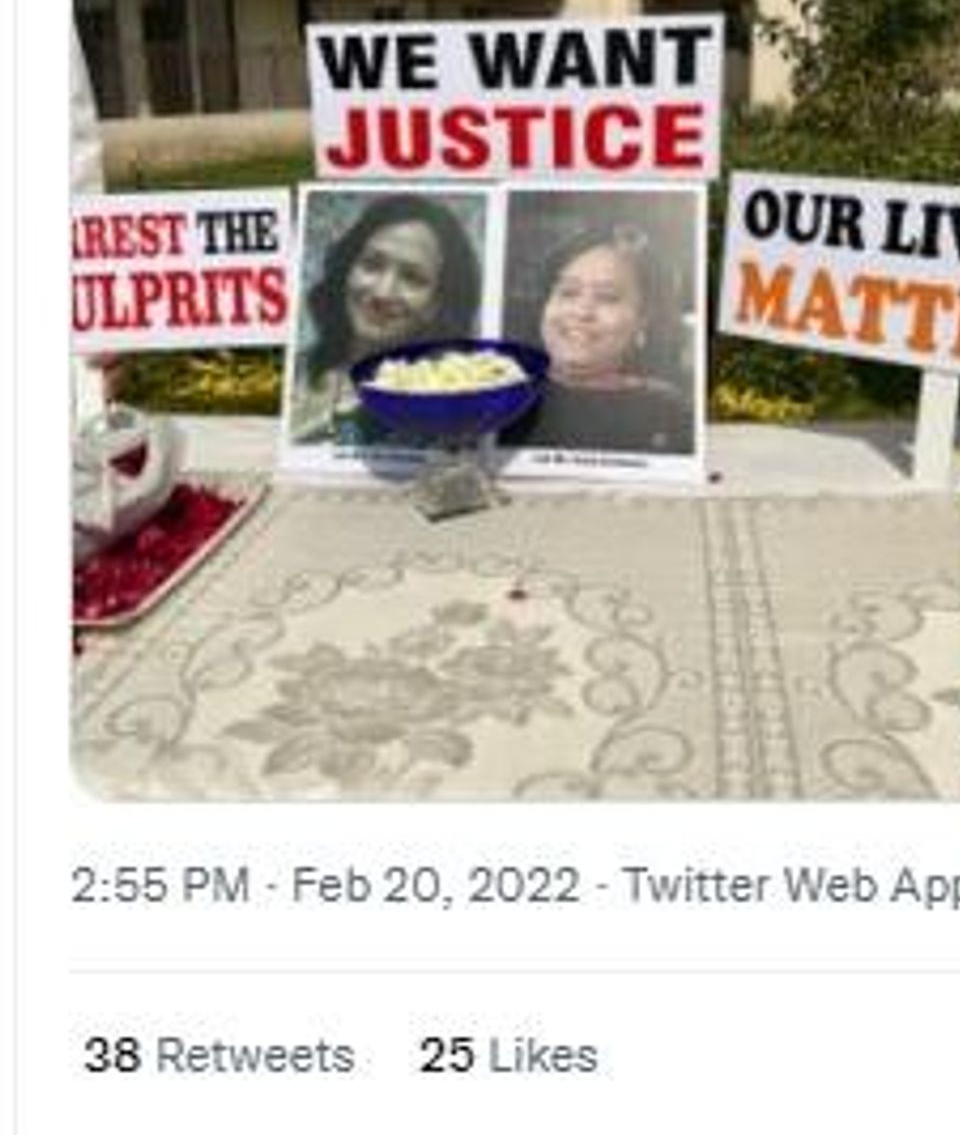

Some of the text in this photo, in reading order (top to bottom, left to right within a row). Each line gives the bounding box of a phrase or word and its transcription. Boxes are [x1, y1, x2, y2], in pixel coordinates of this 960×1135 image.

[317, 27, 712, 89] WE WANT
[327, 103, 706, 171] JUSTICE
[196, 208, 280, 254] THE
[744, 188, 865, 250] OUR
[73, 867, 167, 903] 2:55
[184, 867, 248, 902] PM
[294, 867, 371, 903] Feb
[385, 867, 453, 910] 20,
[469, 867, 579, 903] 2022
[622, 867, 770, 903] Twitter
[783, 867, 878, 903] Web
[85, 1037, 355, 1073] 38 Retweets
[420, 1037, 598, 1073] 25 Likes
